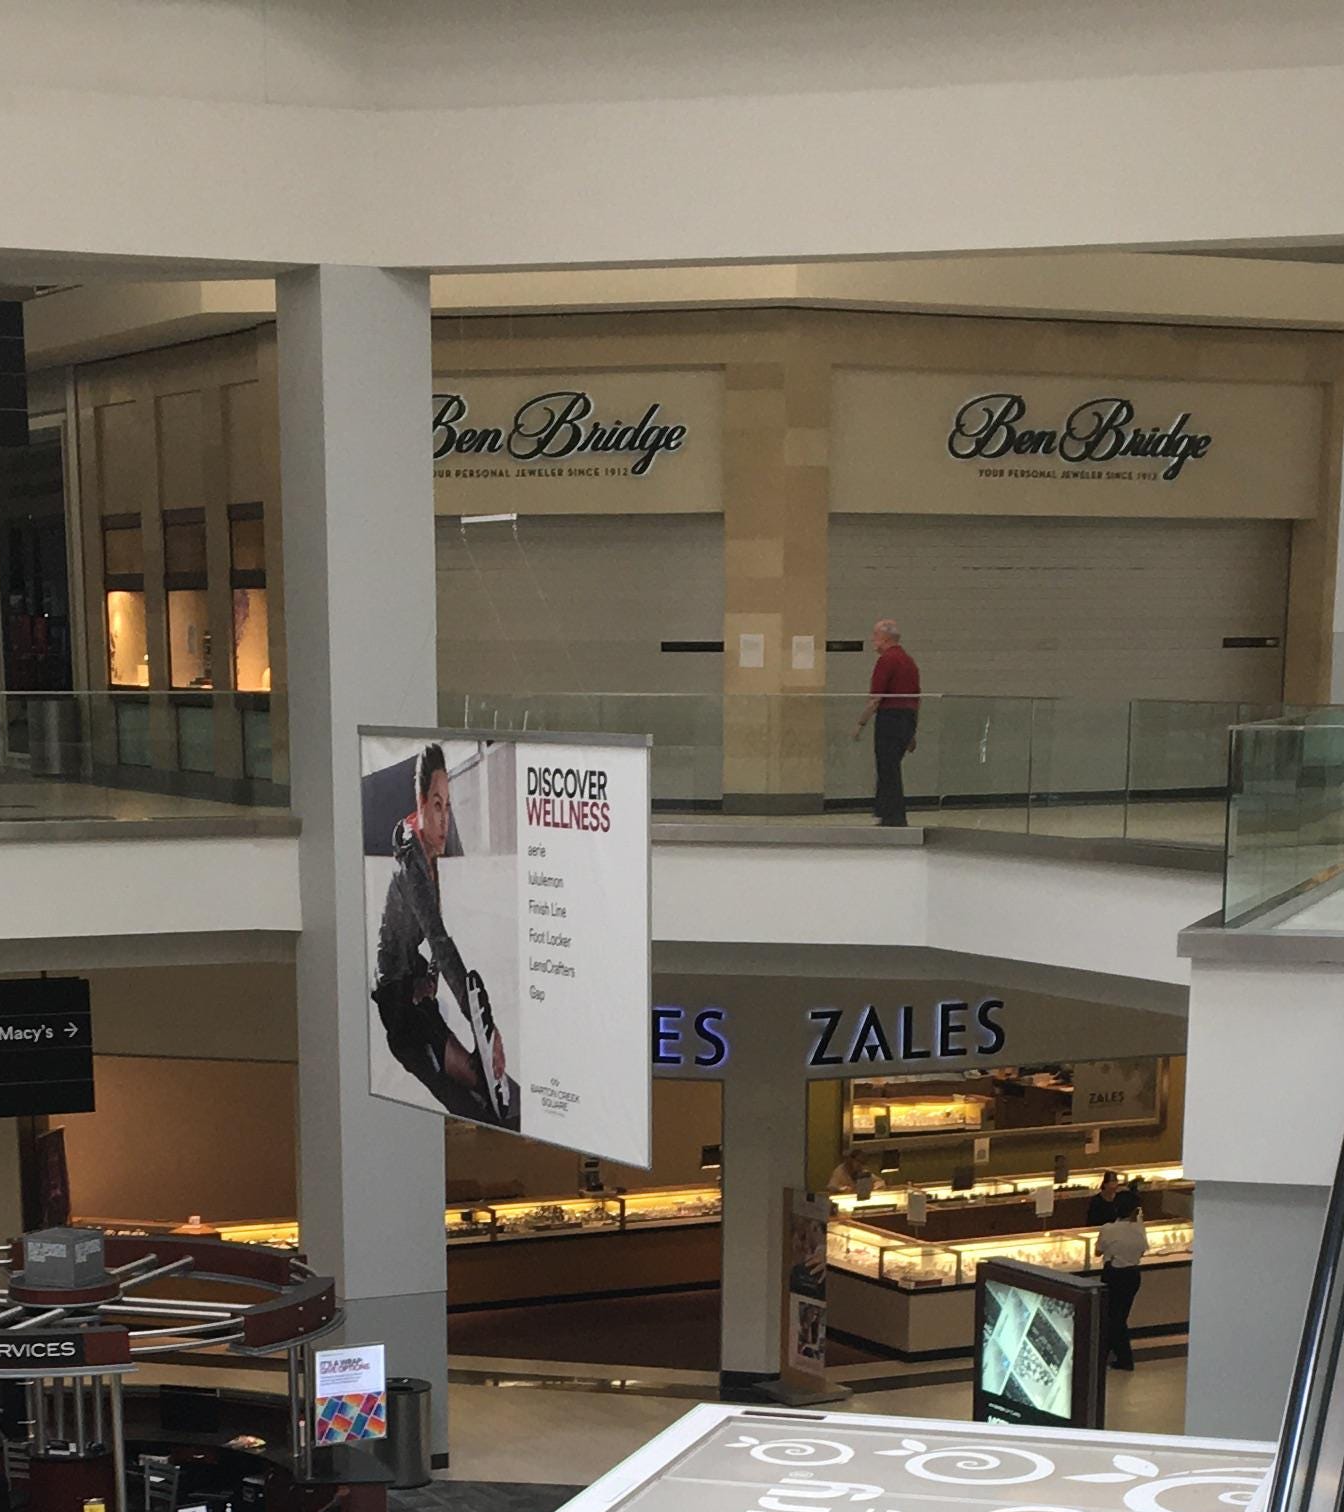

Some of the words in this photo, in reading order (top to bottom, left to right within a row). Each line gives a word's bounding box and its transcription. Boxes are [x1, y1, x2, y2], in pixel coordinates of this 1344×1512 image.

[506, 391, 688, 476] Bridge
[947, 393, 1056, 460] Ben
[1058, 397, 1212, 480] Bridge
[455, 468, 510, 479] PERSONAL
[515, 468, 563, 478] JEWELER
[567, 467, 600, 477] SINCE
[604, 467, 629, 477] 1912
[978, 468, 1004, 479] YOUR
[1008, 469, 1056, 479] PERSONAL
[1060, 470, 1103, 480] JEWELER
[527, 766, 608, 801] DISCOVER
[525, 796, 611, 833] WELLNESS
[527, 842, 547, 858] aerie
[528, 870, 565, 889] lululemon
[528, 899, 550, 916] Finish
[551, 902, 567, 919] Line
[529, 928, 545, 945] Foot
[546, 930, 572, 948] Locker
[529, 984, 546, 1003] Gap
[809, 1000, 1005, 1066] ZALES
[1088, 1090, 1125, 1105] ZALES
